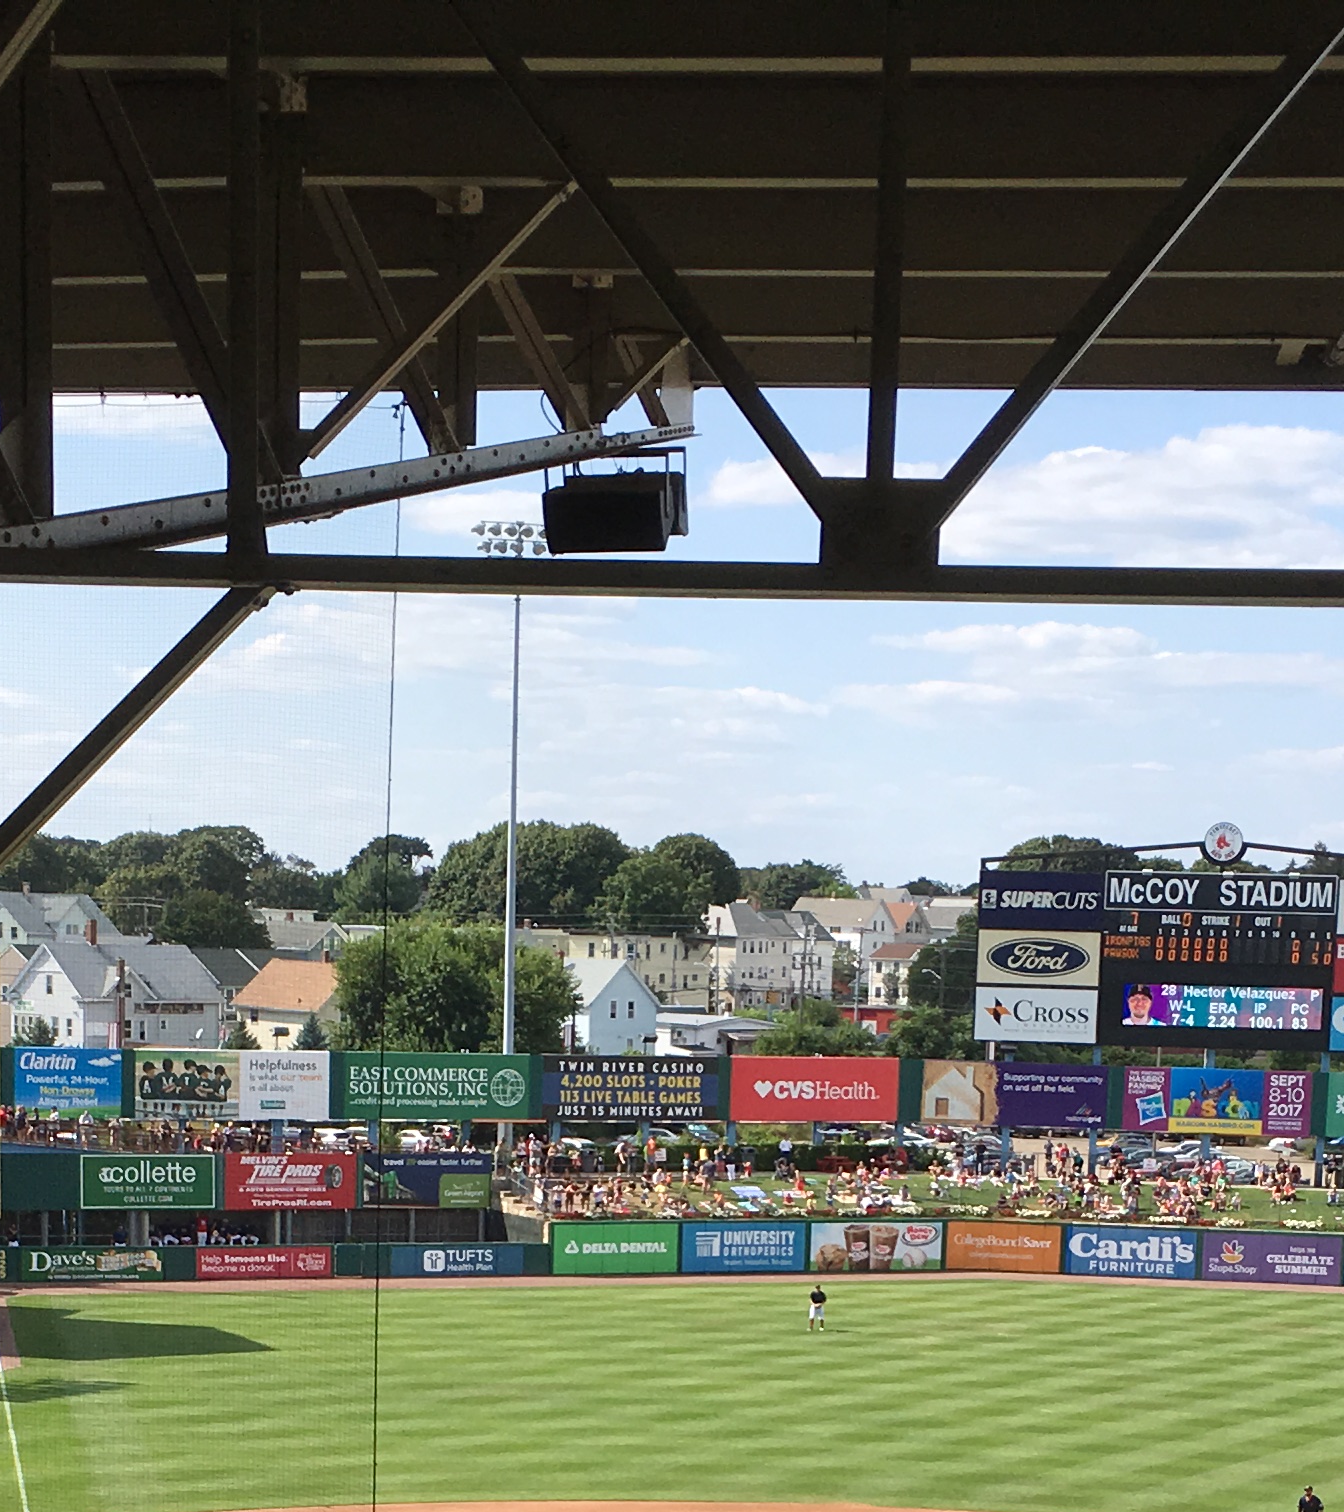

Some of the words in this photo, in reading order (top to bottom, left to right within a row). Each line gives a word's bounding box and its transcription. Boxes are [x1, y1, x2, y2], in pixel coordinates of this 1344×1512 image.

[1109, 878, 1200, 904] McCOY
[1219, 880, 1333, 908] STADIUM
[1000, 891, 1098, 909] SUPERCUTS
[1161, 915, 1181, 924] BALL
[1182, 912, 1192, 927] 0
[1201, 916, 1230, 925] STRIKE
[1254, 917, 1272, 926] OUT
[1008, 943, 1069, 970] Ford
[1161, 985, 1177, 996] 28
[1183, 986, 1227, 998] Hector
[1229, 987, 1296, 1001] Velazquez
[1310, 989, 1320, 1000] P
[1170, 1000, 1196, 1012] W-L
[1209, 1002, 1238, 1014] ERA
[1254, 1003, 1267, 1014] IP
[1291, 1004, 1310, 1015] PC
[1172, 1014, 1195, 1027] 7-4
[1207, 1016, 1236, 1028] 2.24
[1249, 1016, 1284, 1029] 100.1
[1291, 1018, 1308, 1029] 83
[20, 1052, 76, 1070] Claritin
[249, 1059, 318, 1072] Helpfulness
[559, 1060, 594, 1072] TWIN
[603, 1061, 645, 1073] RIVER
[653, 1062, 704, 1074] CASINO
[26, 1074, 69, 1085] Powerful,
[258, 1073, 278, 1081] what
[349, 1066, 391, 1080] EAST
[393, 1067, 488, 1081] COMMERCE
[1003, 1073, 1045, 1084] Supporting
[1061, 1075, 1104, 1085] community
[561, 1075, 602, 1089] 4,200
[607, 1075, 646, 1088] SLOTS
[659, 1076, 701, 1089] POKER
[1270, 1075, 1306, 1087] SEPT
[349, 1081, 453, 1098] SOLUTIONS,
[457, 1083, 488, 1096] INC
[1015, 1084, 1029, 1092] and
[1044, 1084, 1056, 1092] the
[560, 1090, 580, 1103] 113
[584, 1091, 611, 1103] LIVE
[616, 1091, 655, 1104] TABLE
[659, 1091, 701, 1104] GAMES
[1269, 1087, 1305, 1103] 8-10
[396, 1097, 438, 1107] processing
[461, 1098, 487, 1107] simple
[557, 1105, 586, 1116] JUST
[592, 1105, 604, 1116] 15
[610, 1105, 662, 1117] MINUTES
[667, 1106, 703, 1117] AWAY!
[1268, 1104, 1303, 1116] 2017
[240, 1155, 288, 1165] MELVIN'S
[111, 1160, 197, 1183] collette
[252, 1165, 284, 1183] TIRE
[283, 1165, 324, 1183] PROS
[723, 1231, 795, 1246] UNIVERSITY
[583, 1242, 619, 1253] DELTA
[621, 1242, 667, 1253] DENTAL
[723, 1247, 794, 1256] ORTHOPEDICS
[1069, 1232, 1195, 1263] Cardi's
[29, 1250, 95, 1272] Dave's
[201, 1255, 222, 1264] Help
[224, 1255, 265, 1263] Someone
[447, 1250, 494, 1262] TUFTS
[1266, 1254, 1334, 1266] CELEBRATE
[202, 1264, 238, 1272] Become
[447, 1263, 474, 1271] Health
[476, 1263, 493, 1271] Plan
[1089, 1260, 1175, 1274] FURNITURE
[1274, 1264, 1328, 1276] SUMMER
